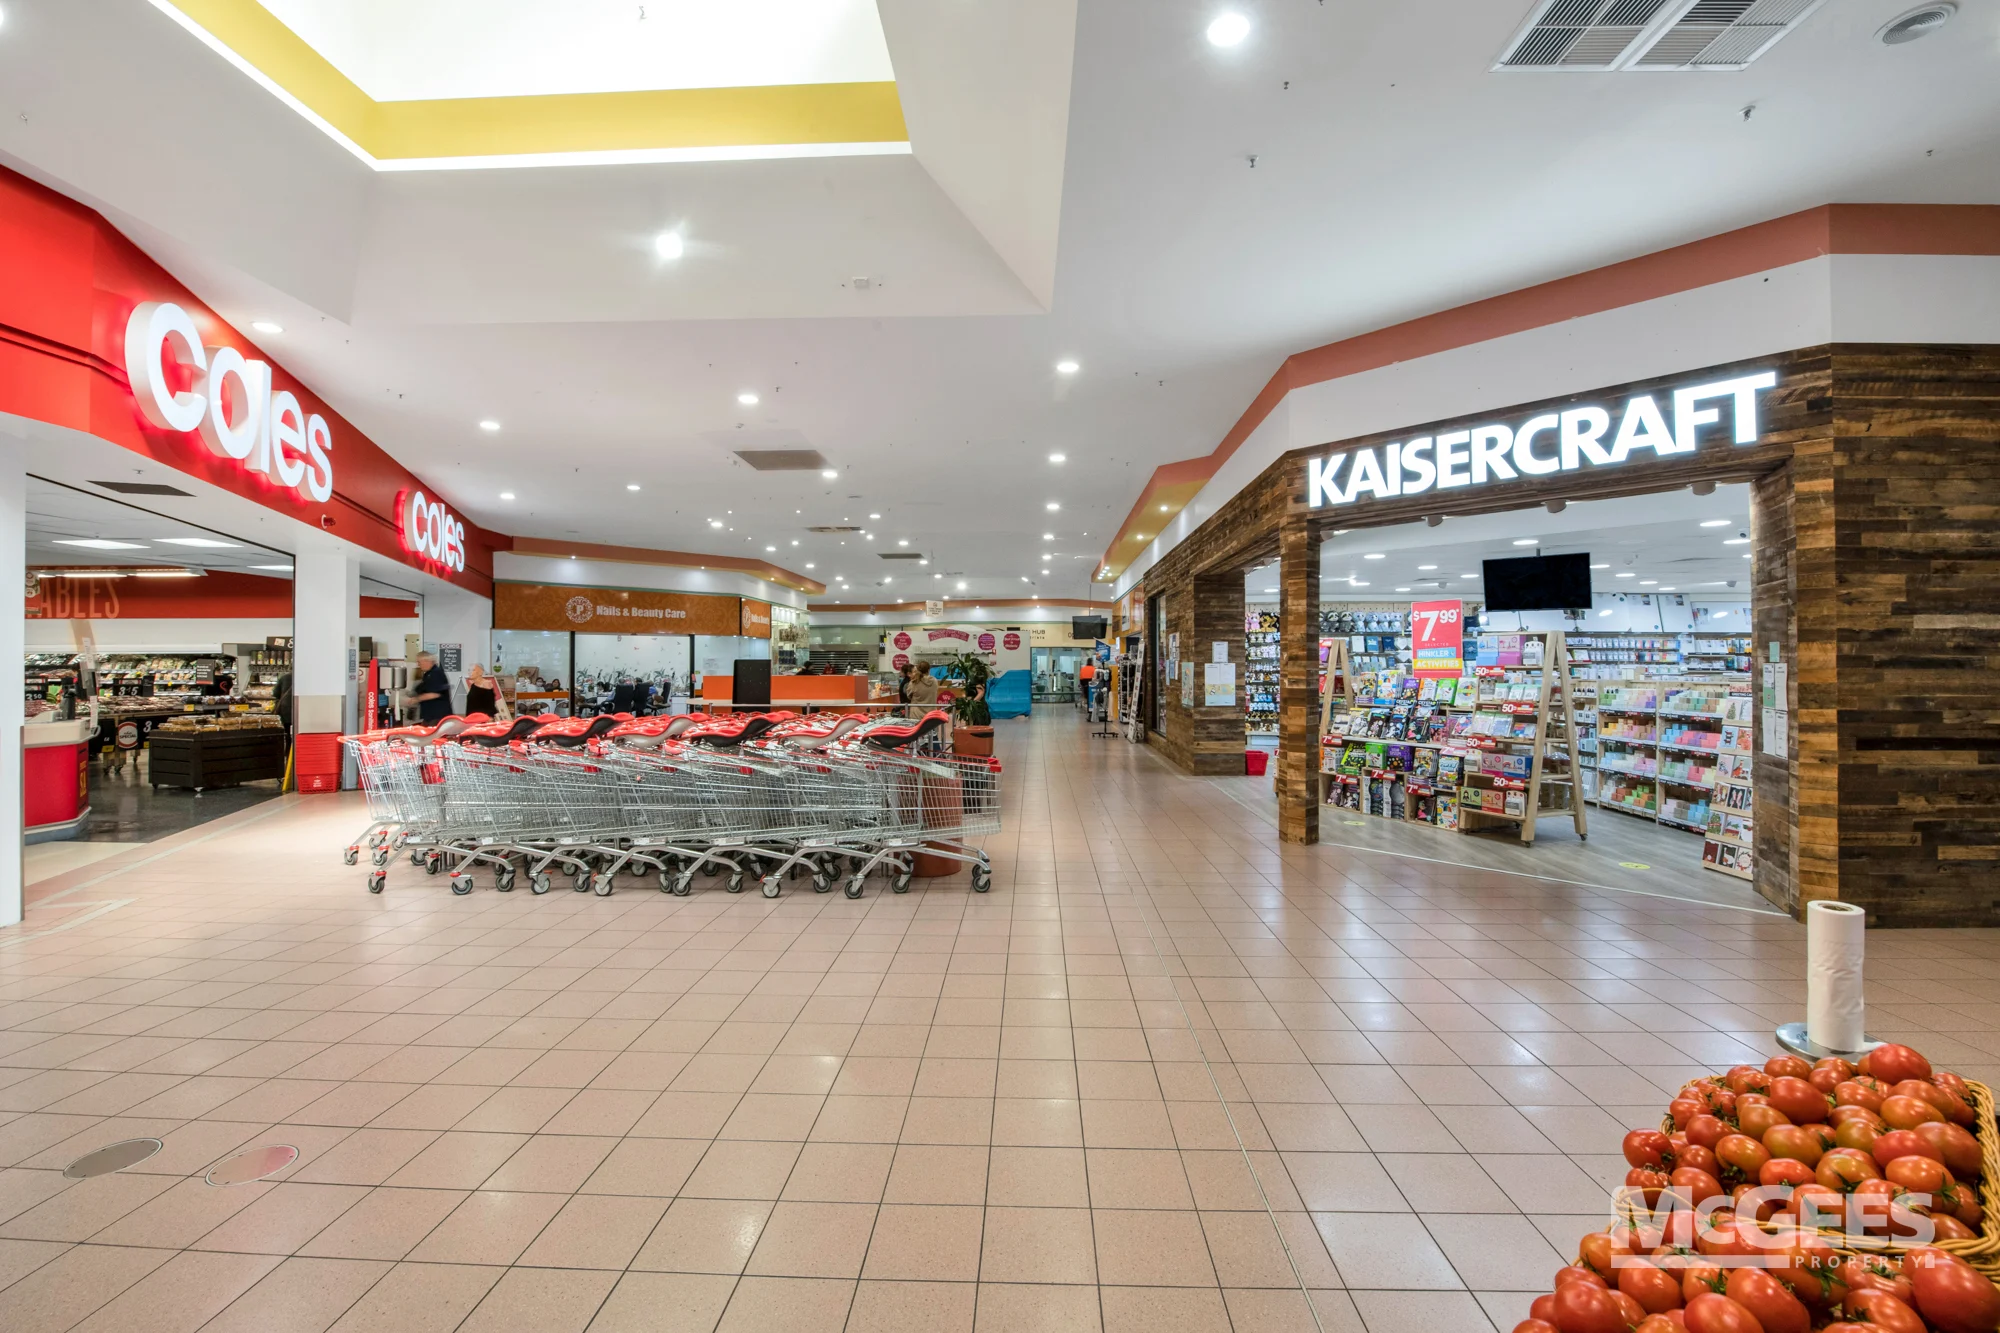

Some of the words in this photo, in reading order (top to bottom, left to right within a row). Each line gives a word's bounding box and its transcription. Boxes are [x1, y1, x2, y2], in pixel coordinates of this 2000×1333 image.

[125, 302, 332, 503] coles
[1308, 371, 1776, 507] KAISERCRAFT
[404, 491, 466, 572] coles
[596, 605, 621, 616] Nails
[622, 608, 630, 616] &
[631, 607, 664, 619] Beauty
[664, 608, 686, 619] Care
[1416, 659, 1459, 668] ACTIVITIES
[1418, 649, 1449, 658] HINKLER
